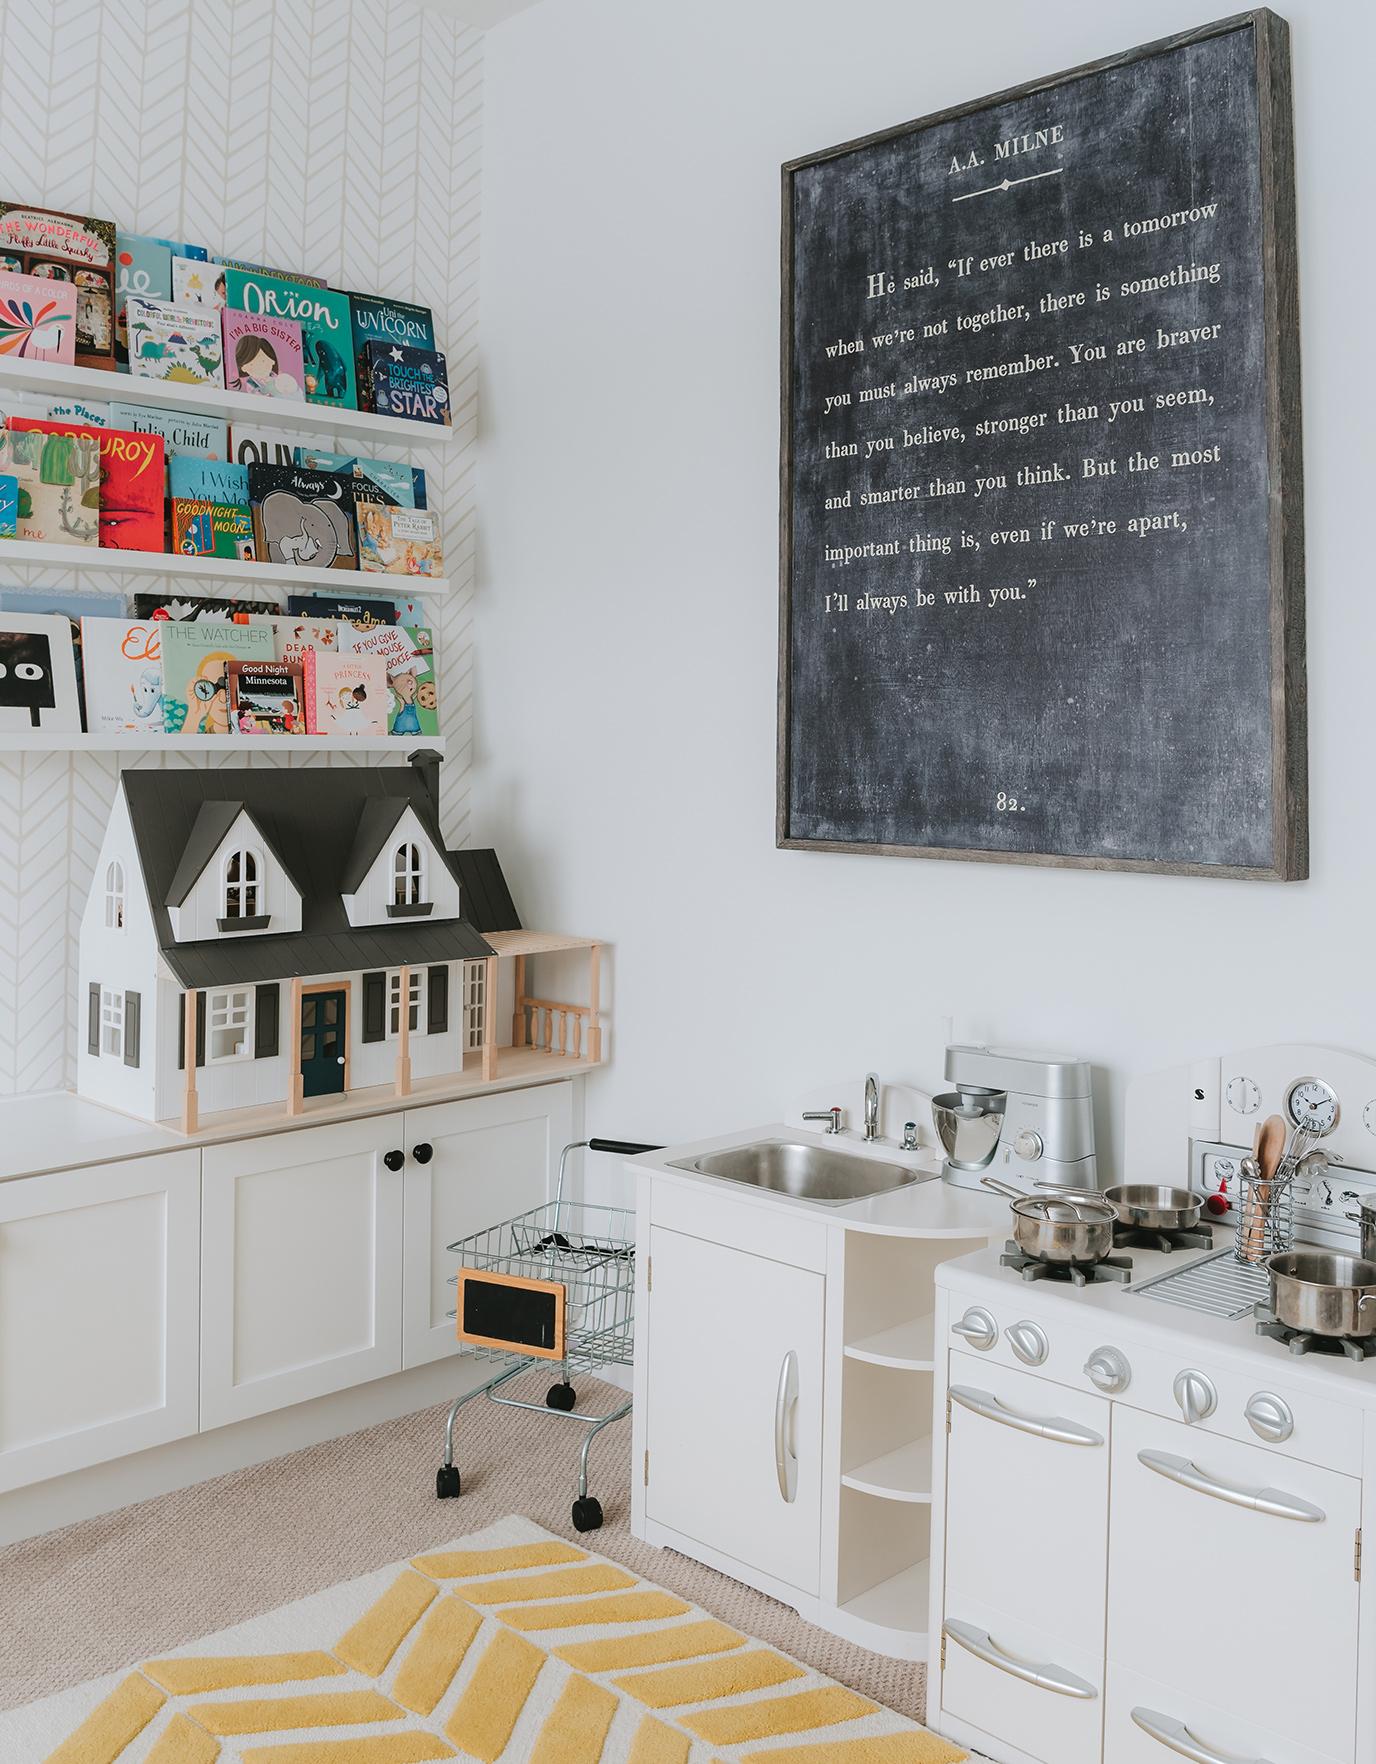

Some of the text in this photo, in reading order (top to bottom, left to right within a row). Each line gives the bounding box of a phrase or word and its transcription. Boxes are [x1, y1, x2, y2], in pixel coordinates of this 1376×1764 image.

[948, 124, 1064, 175] A.A. MILNE
[24, 221, 99, 251] WONDERFUL
[866, 271, 896, 299] He
[903, 266, 940, 290] said,
[979, 252, 1015, 272] ever
[1023, 239, 1069, 261] there
[1078, 230, 1093, 249] is
[1102, 229, 1114, 243] a
[1123, 203, 1218, 238] tomorrow
[825, 339, 865, 358] when
[923, 319, 948, 338] not
[956, 303, 1030, 333] together,
[1039, 292, 1086, 314] there
[1095, 282, 1111, 302] is
[1120, 262, 1221, 297] something
[229, 322, 301, 352] I'M A BIG SISTER
[388, 363, 434, 383] TOUCH THE
[824, 324, 1222, 415] you must always remember. You are braver
[389, 376, 435, 395] BRIGHTEST
[390, 390, 438, 419] STAR
[53, 406, 71, 415] the
[74, 405, 106, 426] Places
[825, 388, 1214, 459] than you believe, stronger than you seem,
[173, 428, 210, 449] Child
[201, 471, 249, 490] I Wish
[291, 475, 325, 493] Always
[352, 482, 379, 493] FOCUS
[824, 445, 1221, 510] and smarter than you think. But the most
[177, 503, 238, 518] GOODNIGHT
[214, 521, 245, 533] MOON
[825, 539, 901, 569] important
[909, 533, 952, 555] thing
[960, 530, 980, 552] is,
[990, 529, 1031, 545] even
[1040, 520, 1056, 541] if
[1127, 511, 1188, 538] apart,
[856, 591, 908, 616] always
[915, 588, 936, 607] be
[943, 584, 981, 605] with
[167, 626, 268, 643] THE WATCHER
[352, 630, 398, 654] IF YOU GIVE
[286, 644, 314, 652] DEAR
[242, 664, 288, 675] Good Night
[245, 676, 287, 685] Minnesota
[996, 791, 1026, 812] 82.
[1194, 1088, 1205, 1100] S
